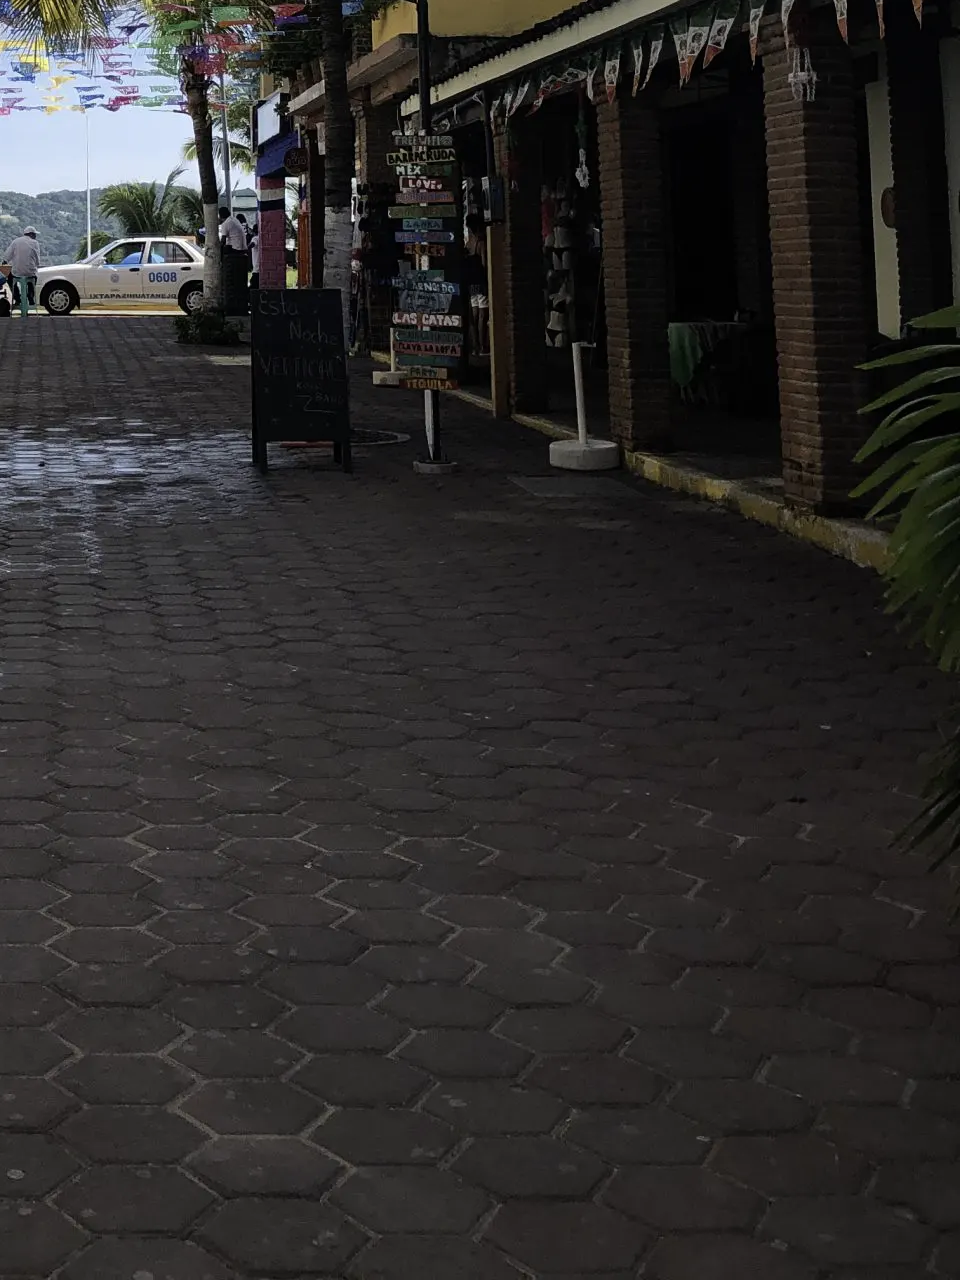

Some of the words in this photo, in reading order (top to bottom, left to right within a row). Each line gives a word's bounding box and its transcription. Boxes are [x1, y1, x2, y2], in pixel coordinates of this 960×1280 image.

[408, 179, 437, 190] LOVE
[148, 272, 177, 283] 0608
[258, 291, 299, 316] Esta
[394, 312, 418, 325] LAS
[289, 317, 339, 345] Noche
[424, 344, 434, 353] LA
[406, 379, 453, 390] TEQUILA
